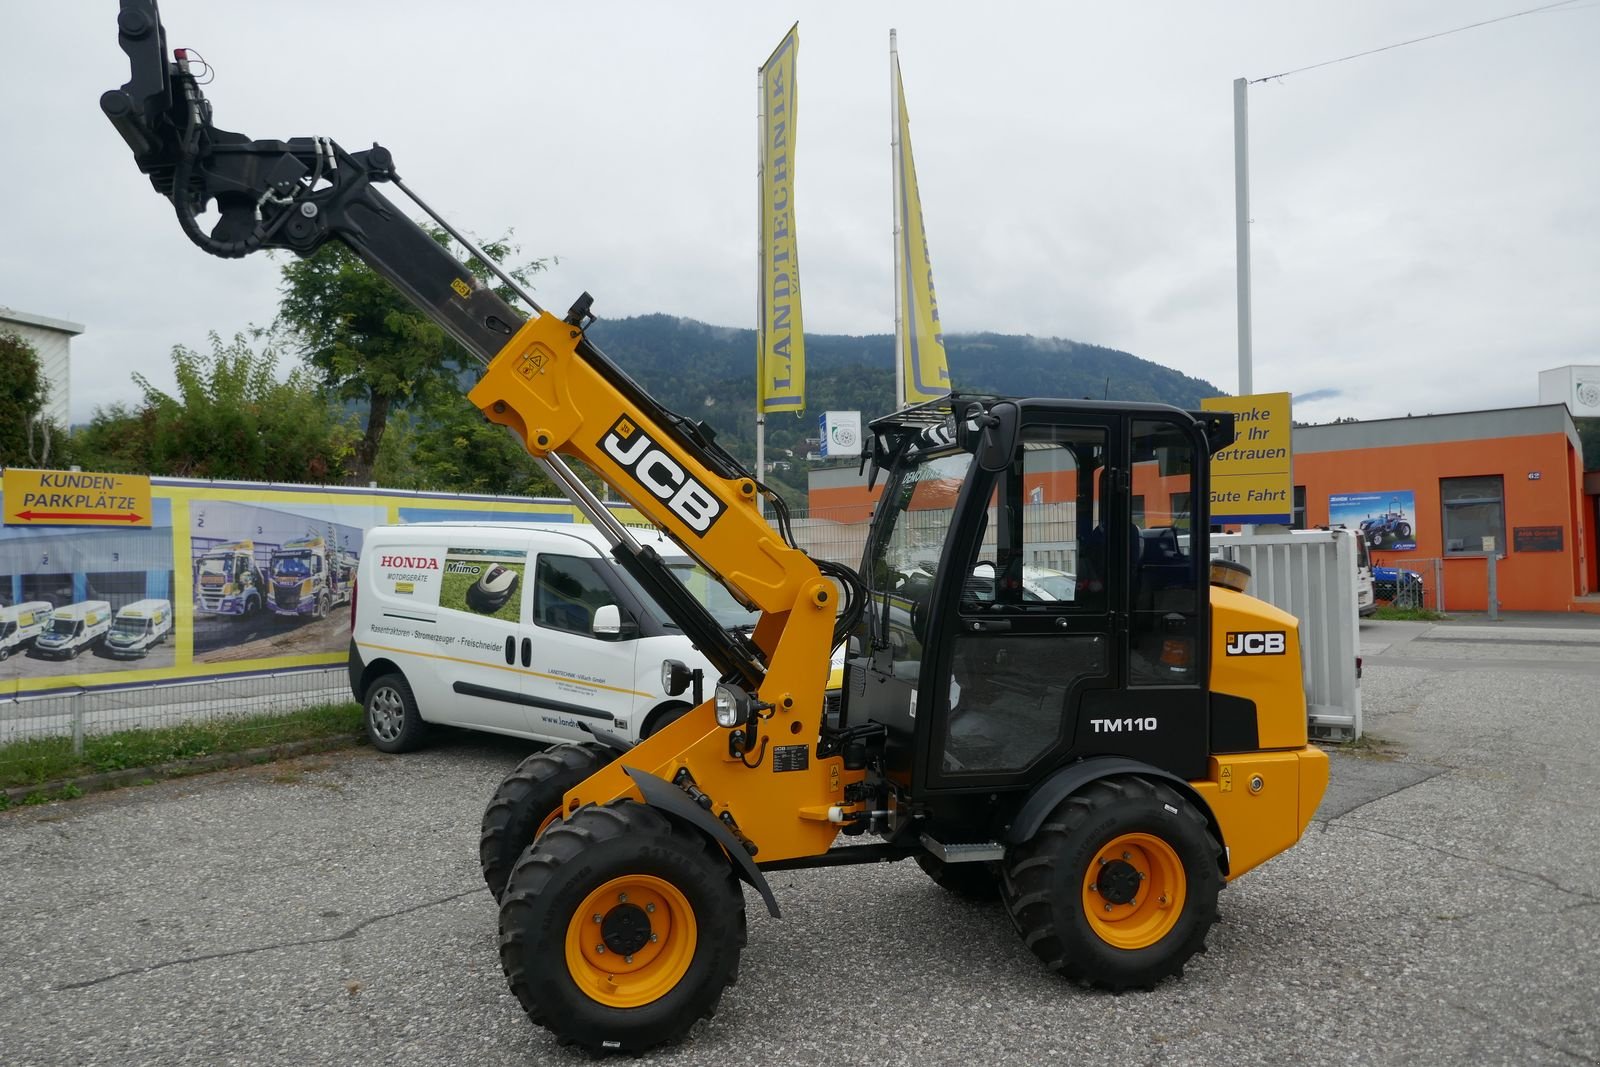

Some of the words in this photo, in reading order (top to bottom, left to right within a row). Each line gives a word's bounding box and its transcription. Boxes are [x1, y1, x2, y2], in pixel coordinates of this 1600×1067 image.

[772, 63, 792, 392] LANDTECHNIK
[1233, 408, 1271, 422] anke
[1248, 427, 1270, 441] Ihr
[40, 474, 123, 490] KUNDEN-
[604, 433, 720, 531] JCB
[23, 491, 136, 510] PARKPLÄTZE
[1209, 491, 1241, 503] Gute
[1247, 489, 1287, 502] Fahrt
[381, 555, 440, 570] HONDA
[370, 623, 411, 638] Rasentraktoren
[414, 630, 456, 645] Stromerzeuger
[1227, 633, 1286, 655] JCB
[1090, 717, 1158, 733] TM110
